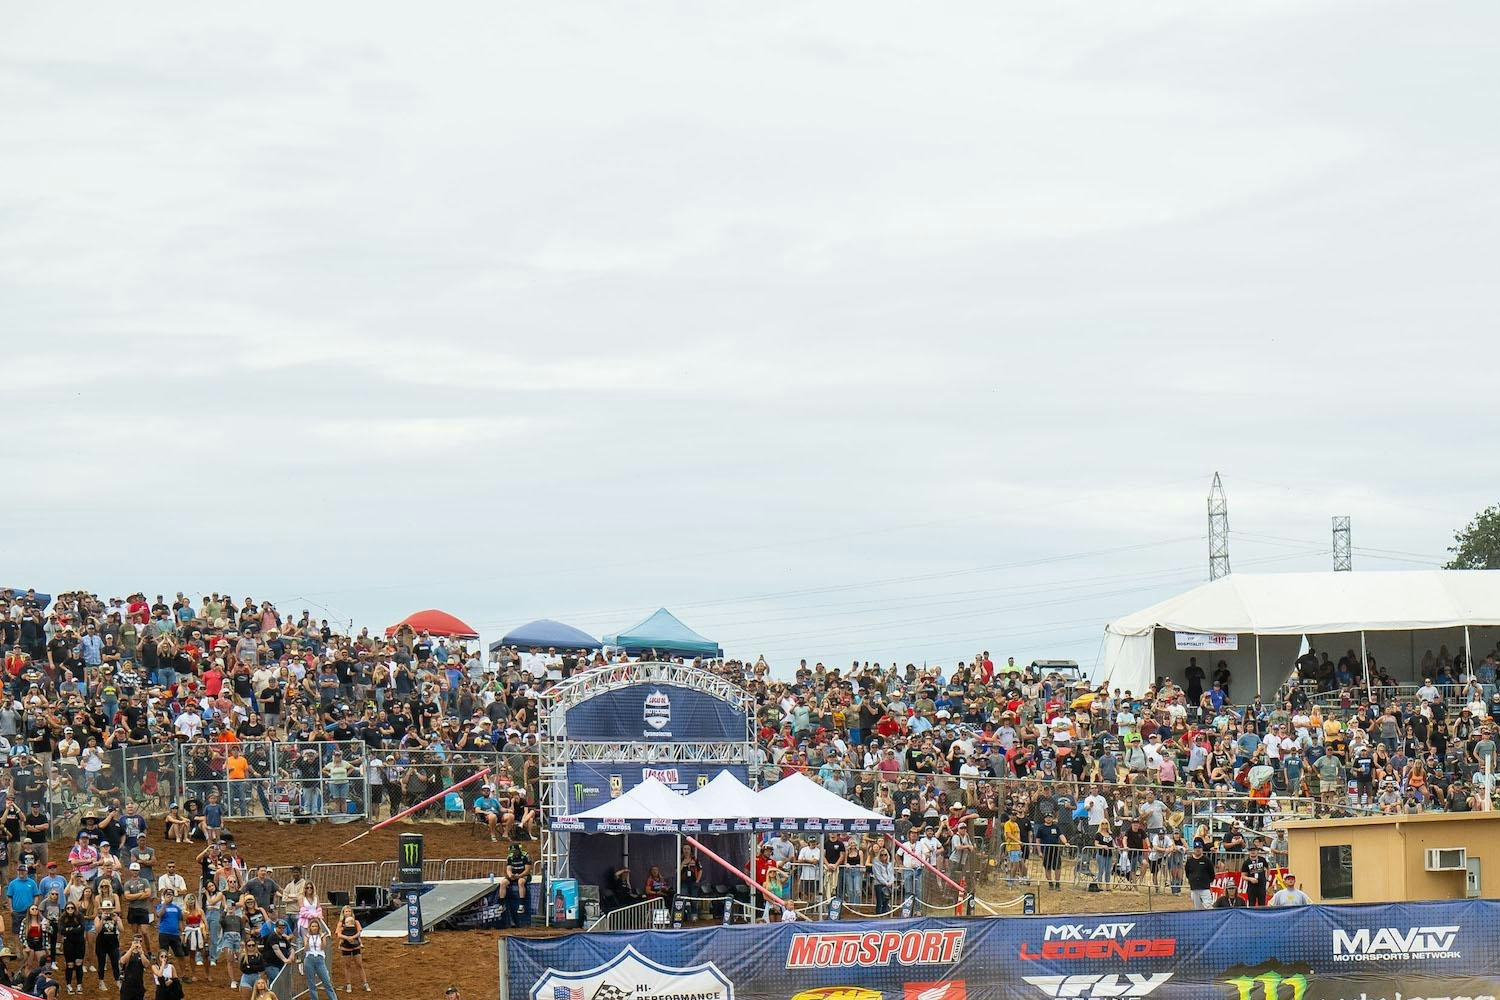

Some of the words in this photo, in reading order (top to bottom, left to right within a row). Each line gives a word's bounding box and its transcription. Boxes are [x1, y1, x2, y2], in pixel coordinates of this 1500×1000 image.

[1044, 924, 1084, 941] MX
[1089, 922, 1137, 940] ATV
[1332, 925, 1460, 954] MAVTV
[1019, 938, 1177, 961] LEGENDS
[1333, 953, 1411, 962] MOTORSPORTS
[1411, 951, 1461, 960] NETWORK
[636, 984, 652, 992] HI-
[1030, 972, 1175, 997] FLY
